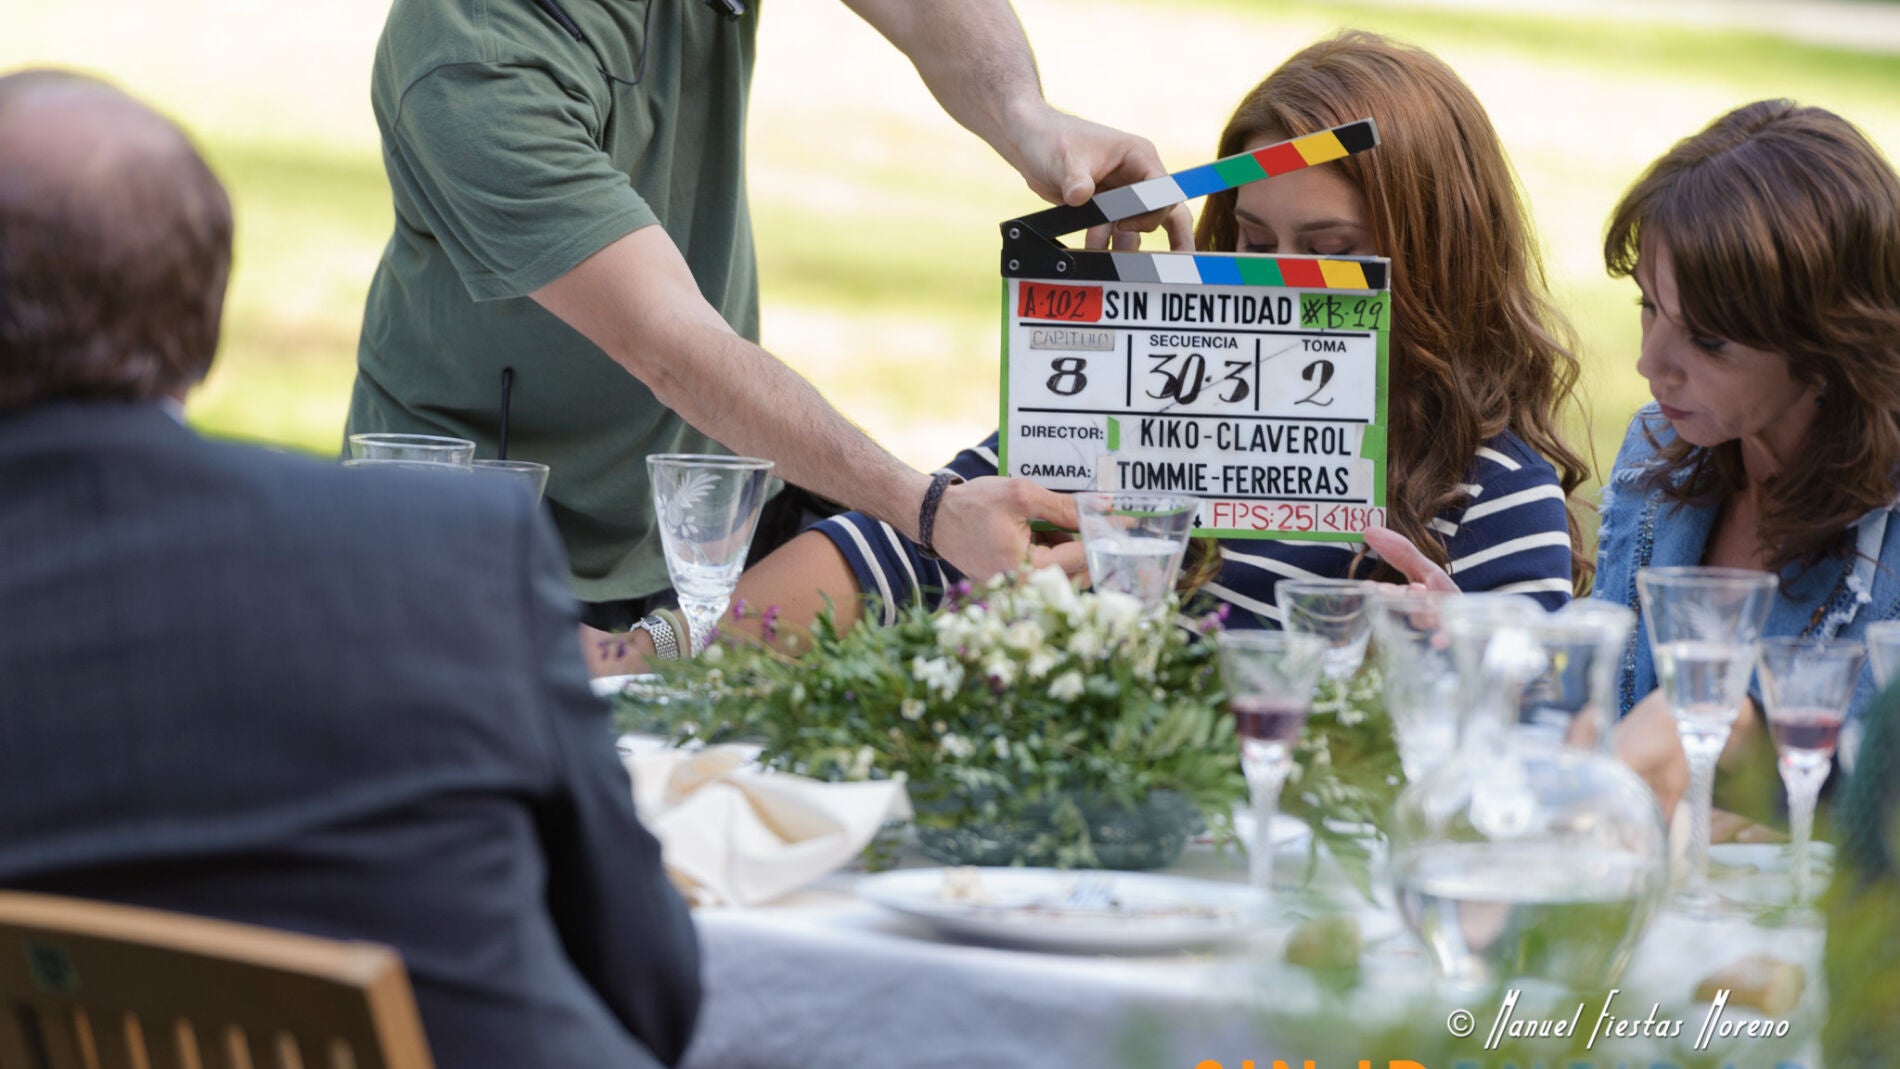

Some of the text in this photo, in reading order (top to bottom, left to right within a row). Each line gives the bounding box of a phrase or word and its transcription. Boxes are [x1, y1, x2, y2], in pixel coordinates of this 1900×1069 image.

[1105, 290, 1292, 325] SIN IDENTIDAD
[1149, 334, 1238, 349] SECUENCIA
[1302, 339, 1347, 352] TOMA
[1046, 357, 1088, 396] 8
[1294, 359, 1335, 407] 2
[1020, 425, 1104, 440] DIRECTOR:
[1140, 418, 1352, 456] KIKO-CLAVEROL
[1020, 463, 1091, 478] CAMARA:
[1117, 461, 1349, 496] TOMMIE-FERRERAS
[1213, 502, 1313, 531] FPS:25
